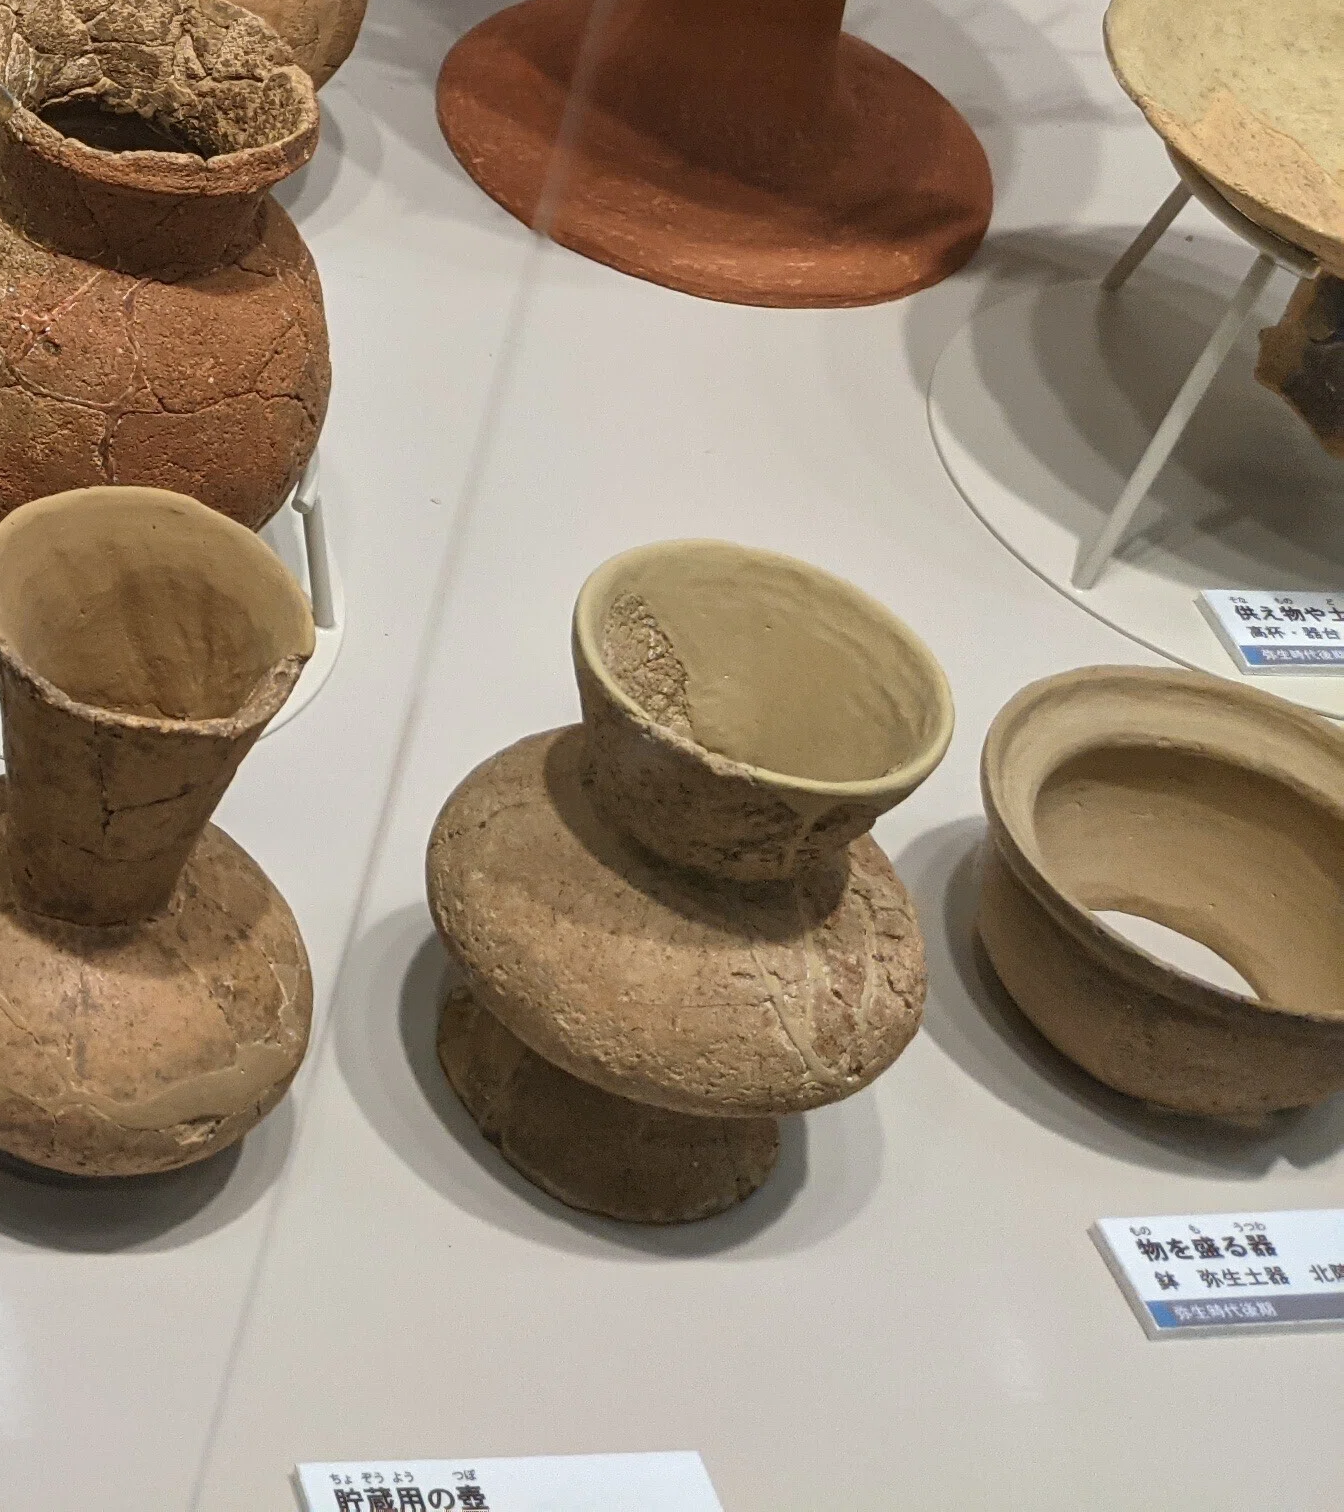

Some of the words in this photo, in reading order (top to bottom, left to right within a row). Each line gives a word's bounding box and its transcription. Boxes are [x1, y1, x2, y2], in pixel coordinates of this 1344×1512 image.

[1136, 1234, 1279, 1263] 物を盛る器
[1195, 1265, 1291, 1289] 弥生土器
